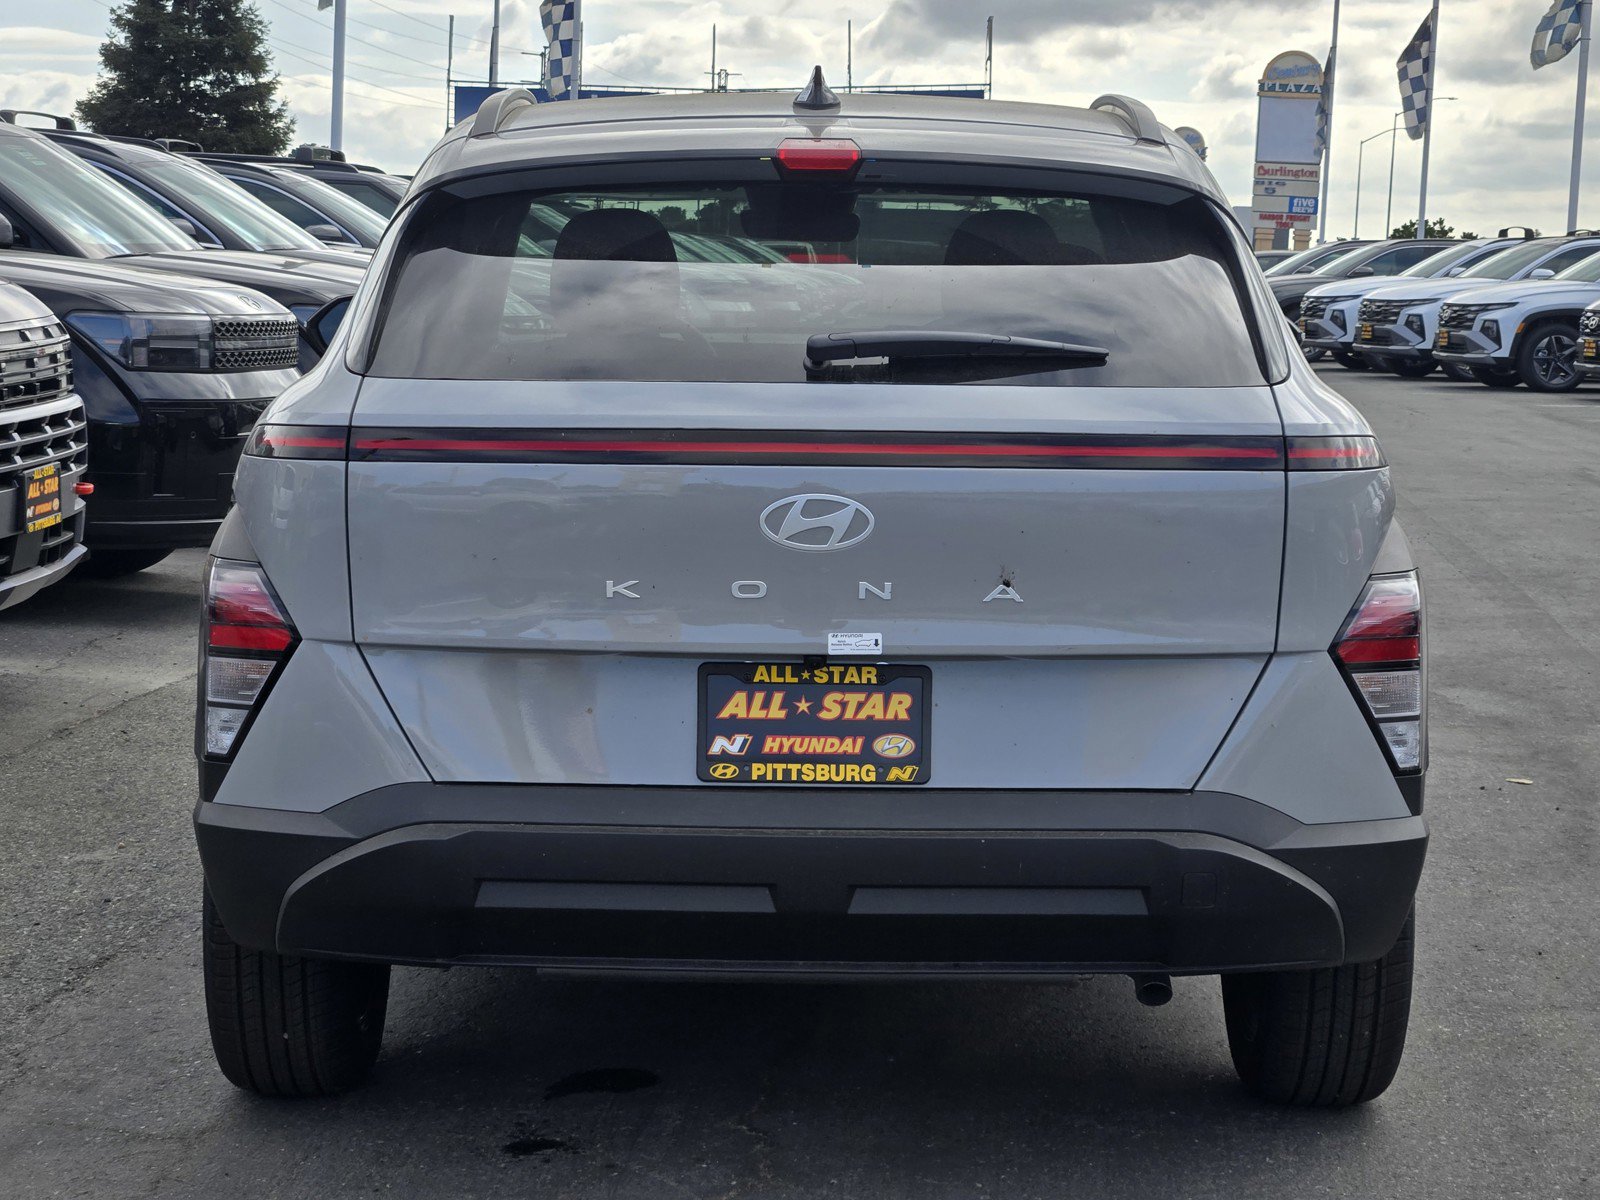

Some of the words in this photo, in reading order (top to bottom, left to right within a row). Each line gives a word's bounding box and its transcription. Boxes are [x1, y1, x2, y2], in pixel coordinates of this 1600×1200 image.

[1264, 82, 1321, 93] PLAZA
[1257, 165, 1318, 178] Burlington
[1293, 197, 1315, 207] five
[28, 481, 40, 499] ALL
[44, 476, 59, 494] STAR
[605, 579, 1024, 603] KONA
[753, 665, 798, 684] ALL
[814, 666, 878, 684] STAR
[716, 690, 788, 720] ALL
[817, 691, 913, 721] STAR
[761, 735, 866, 755] HYUNDAI
[751, 763, 876, 782] PITTSBURG
